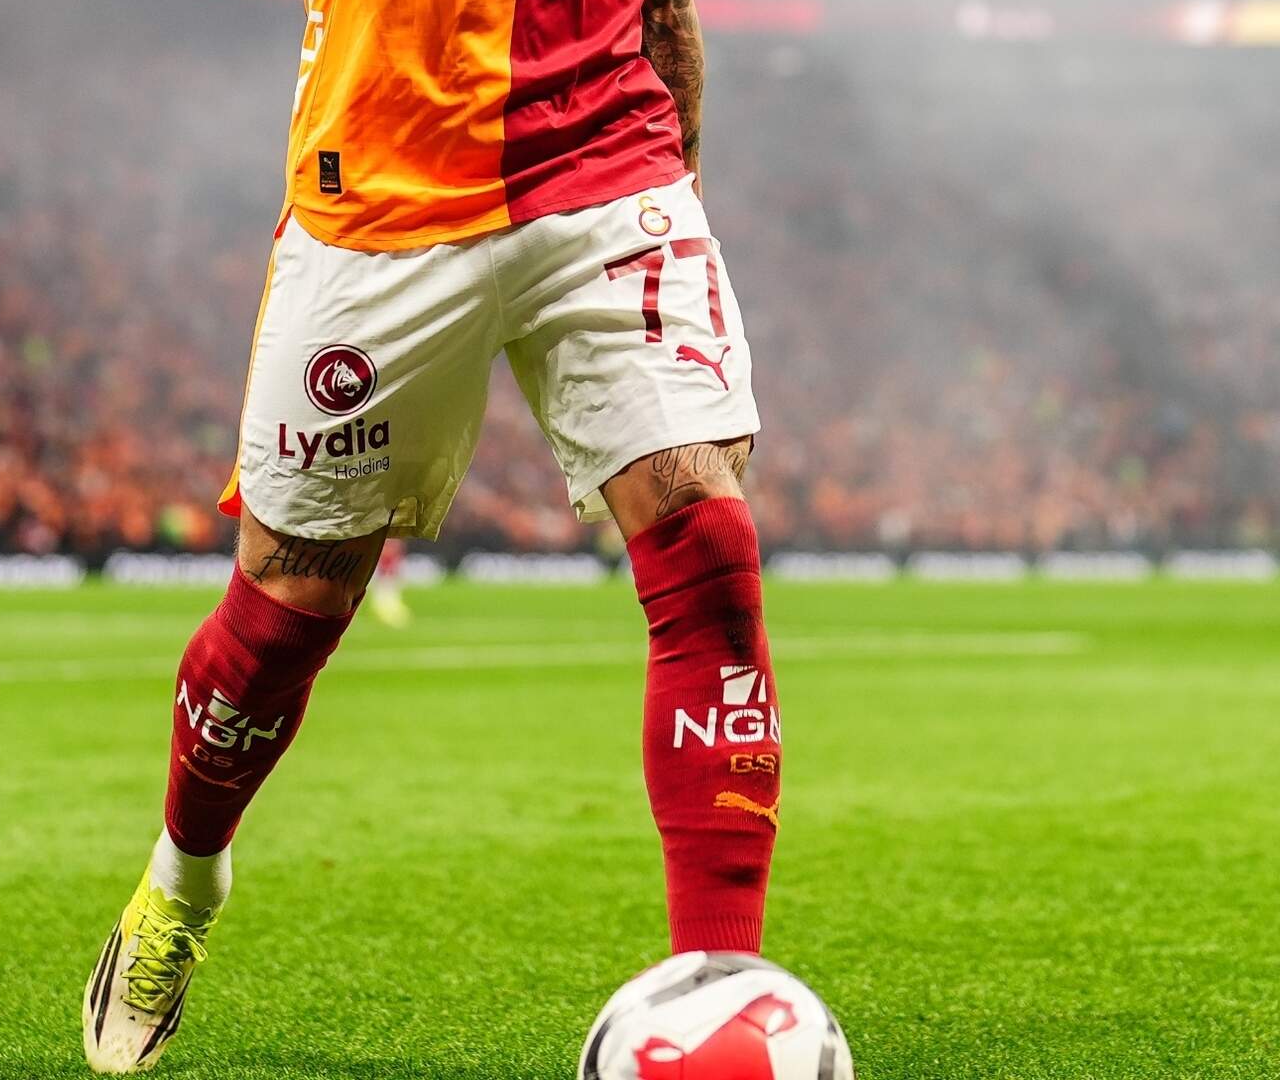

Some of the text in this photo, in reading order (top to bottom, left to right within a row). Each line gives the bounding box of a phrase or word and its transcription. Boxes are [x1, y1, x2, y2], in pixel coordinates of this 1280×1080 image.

[604, 238, 727, 343] 77
[279, 418, 389, 470] Lydia
[335, 456, 390, 479] Holding
